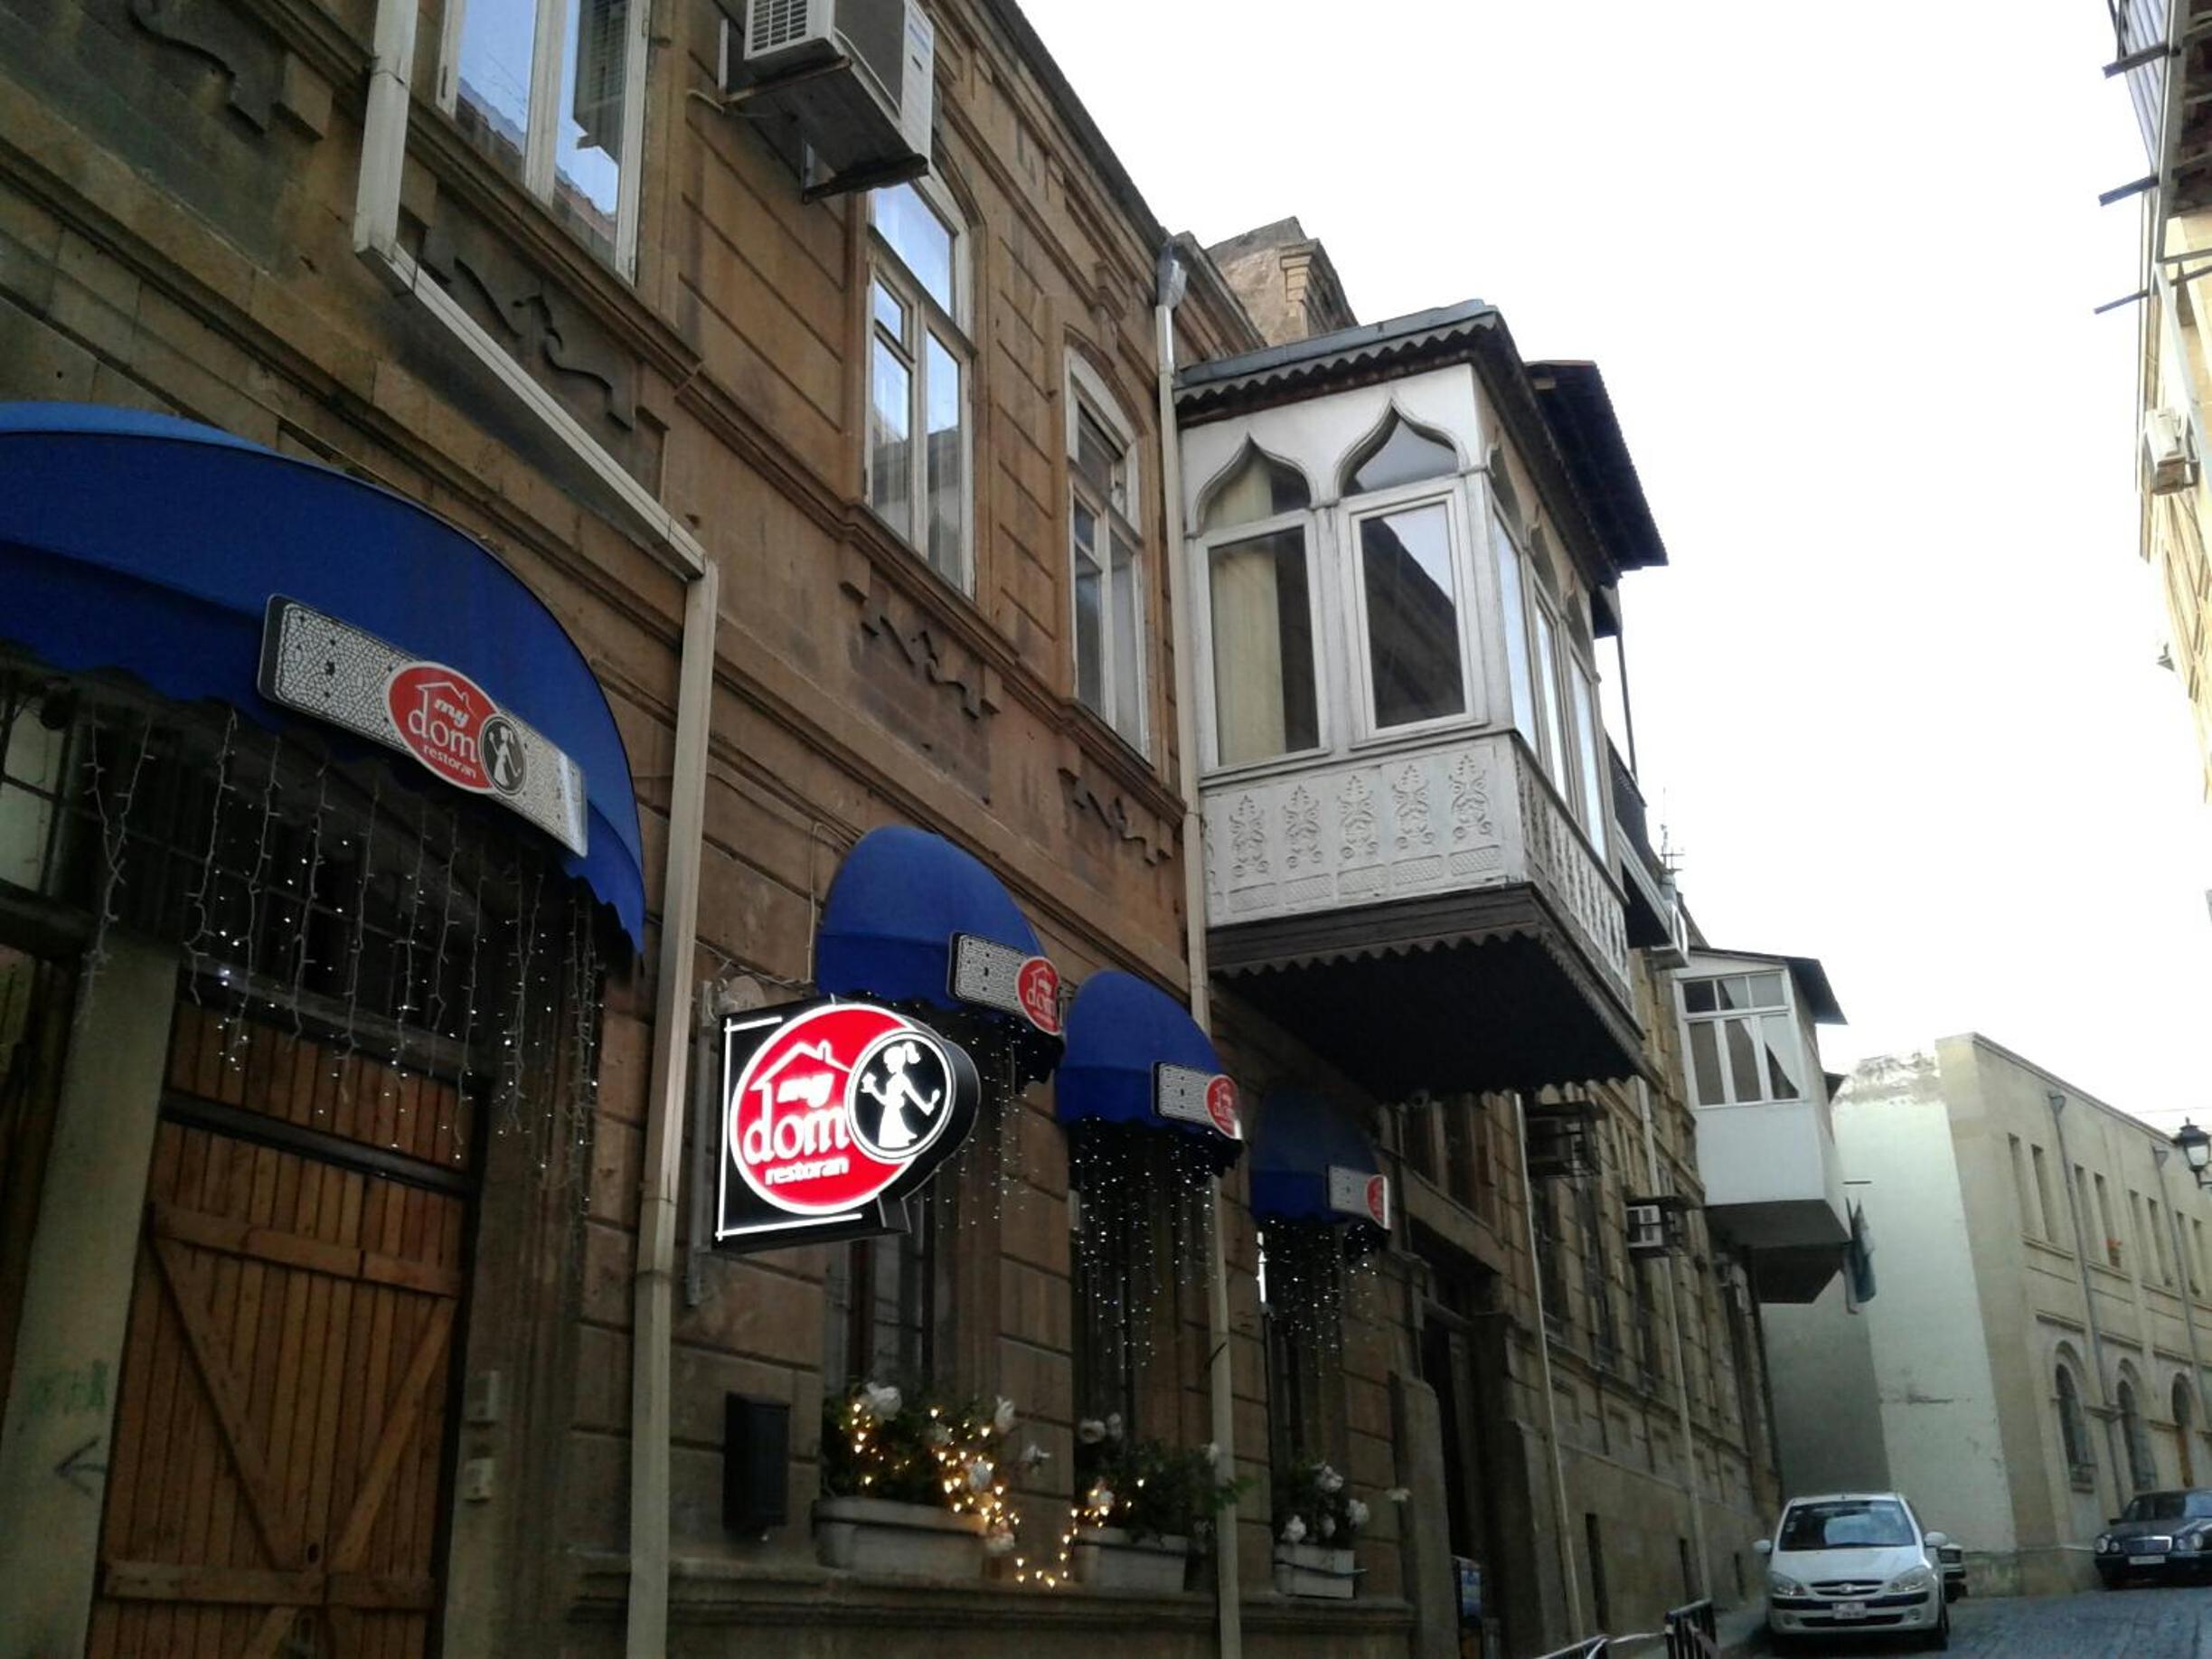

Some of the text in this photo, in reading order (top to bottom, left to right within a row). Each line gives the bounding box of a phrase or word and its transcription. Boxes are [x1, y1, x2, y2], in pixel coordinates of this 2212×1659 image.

[408, 688, 477, 763] dom
[435, 699, 469, 728] my
[424, 744, 477, 779] restoran
[742, 1081, 851, 1164] dom
[765, 1156, 850, 1186] restoran
